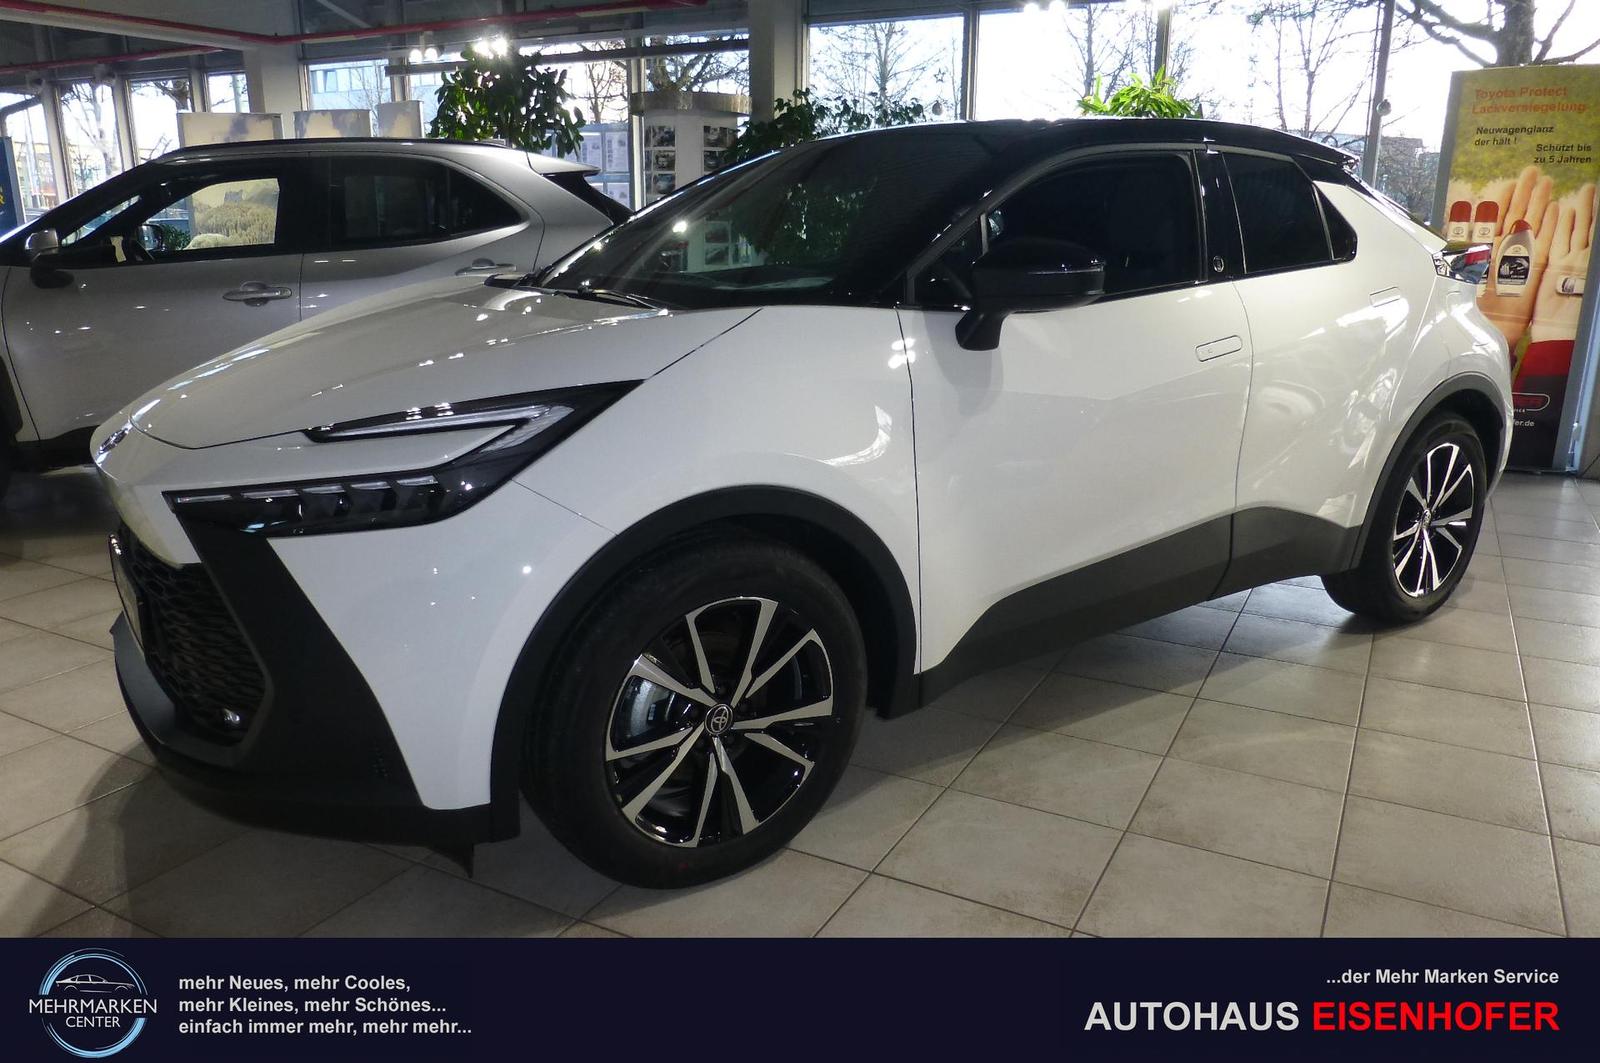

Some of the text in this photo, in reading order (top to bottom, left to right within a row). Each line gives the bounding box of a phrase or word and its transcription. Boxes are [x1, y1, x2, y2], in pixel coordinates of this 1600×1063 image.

[1475, 86, 1568, 100] Toyota Protect
[1472, 102, 1587, 114] Lackversiegelung
[1476, 125, 1554, 135] Neuwagenglanz
[1474, 138, 1490, 146] der
[1536, 143, 1592, 152] Schützt bis
[1549, 155, 1555, 163] 5
[1557, 155, 1592, 163] Jahren
